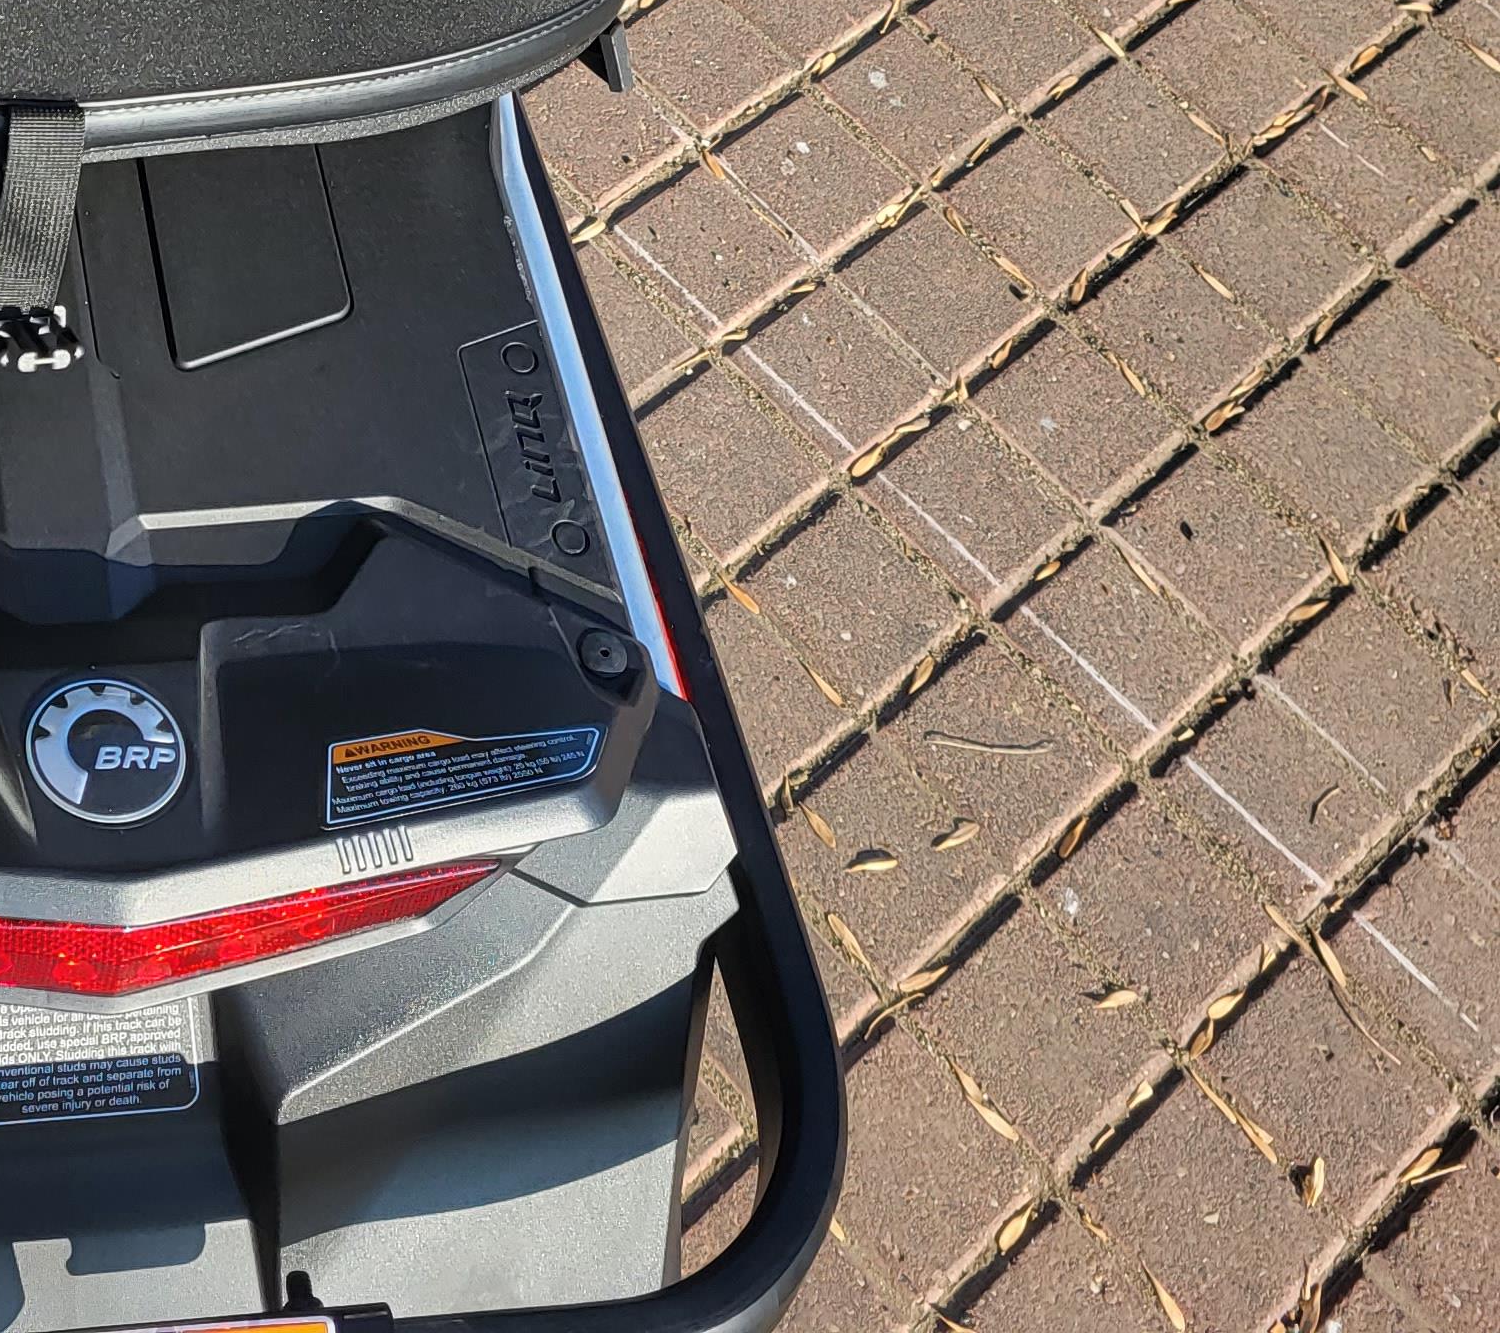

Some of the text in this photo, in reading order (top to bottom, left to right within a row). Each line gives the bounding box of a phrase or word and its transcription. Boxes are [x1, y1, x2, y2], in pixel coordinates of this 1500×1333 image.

[355, 735, 431, 755] WARNING
[94, 746, 176, 770] BRP
[336, 764, 363, 774] Never
[389, 755, 415, 764] cargo
[0, 1028, 27, 1041] track
[28, 1024, 80, 1038] studding.
[82, 1021, 90, 1033] If
[93, 1019, 113, 1033] this
[115, 1017, 142, 1031] track
[144, 1018, 165, 1029] can
[168, 1015, 182, 1027] be
[11, 1013, 50, 1026] vehicle
[53, 1011, 68, 1022] for
[36, 1039, 57, 1051] use
[59, 1035, 99, 1050] special
[55, 1047, 105, 1061] Studding
[108, 1044, 127, 1057] this
[130, 1042, 157, 1055] track
[159, 1039, 181, 1052] with
[57, 1060, 87, 1073] studs
[89, 1059, 113, 1072] may
[115, 1057, 149, 1068] cause
[151, 1053, 182, 1066] studs
[22, 1076, 37, 1089] off
[39, 1075, 50, 1087] of
[52, 1073, 80, 1086] track
[82, 1072, 103, 1083] and
[106, 1067, 154, 1084] separate
[157, 1066, 182, 1078] from
[37, 1088, 74, 1102] posing
[76, 1088, 84, 1097] a
[87, 1082, 134, 1097] potential
[136, 1080, 156, 1092] risk
[158, 1078, 170, 1090] of
[21, 1094, 142, 1114] severe injury or death.
